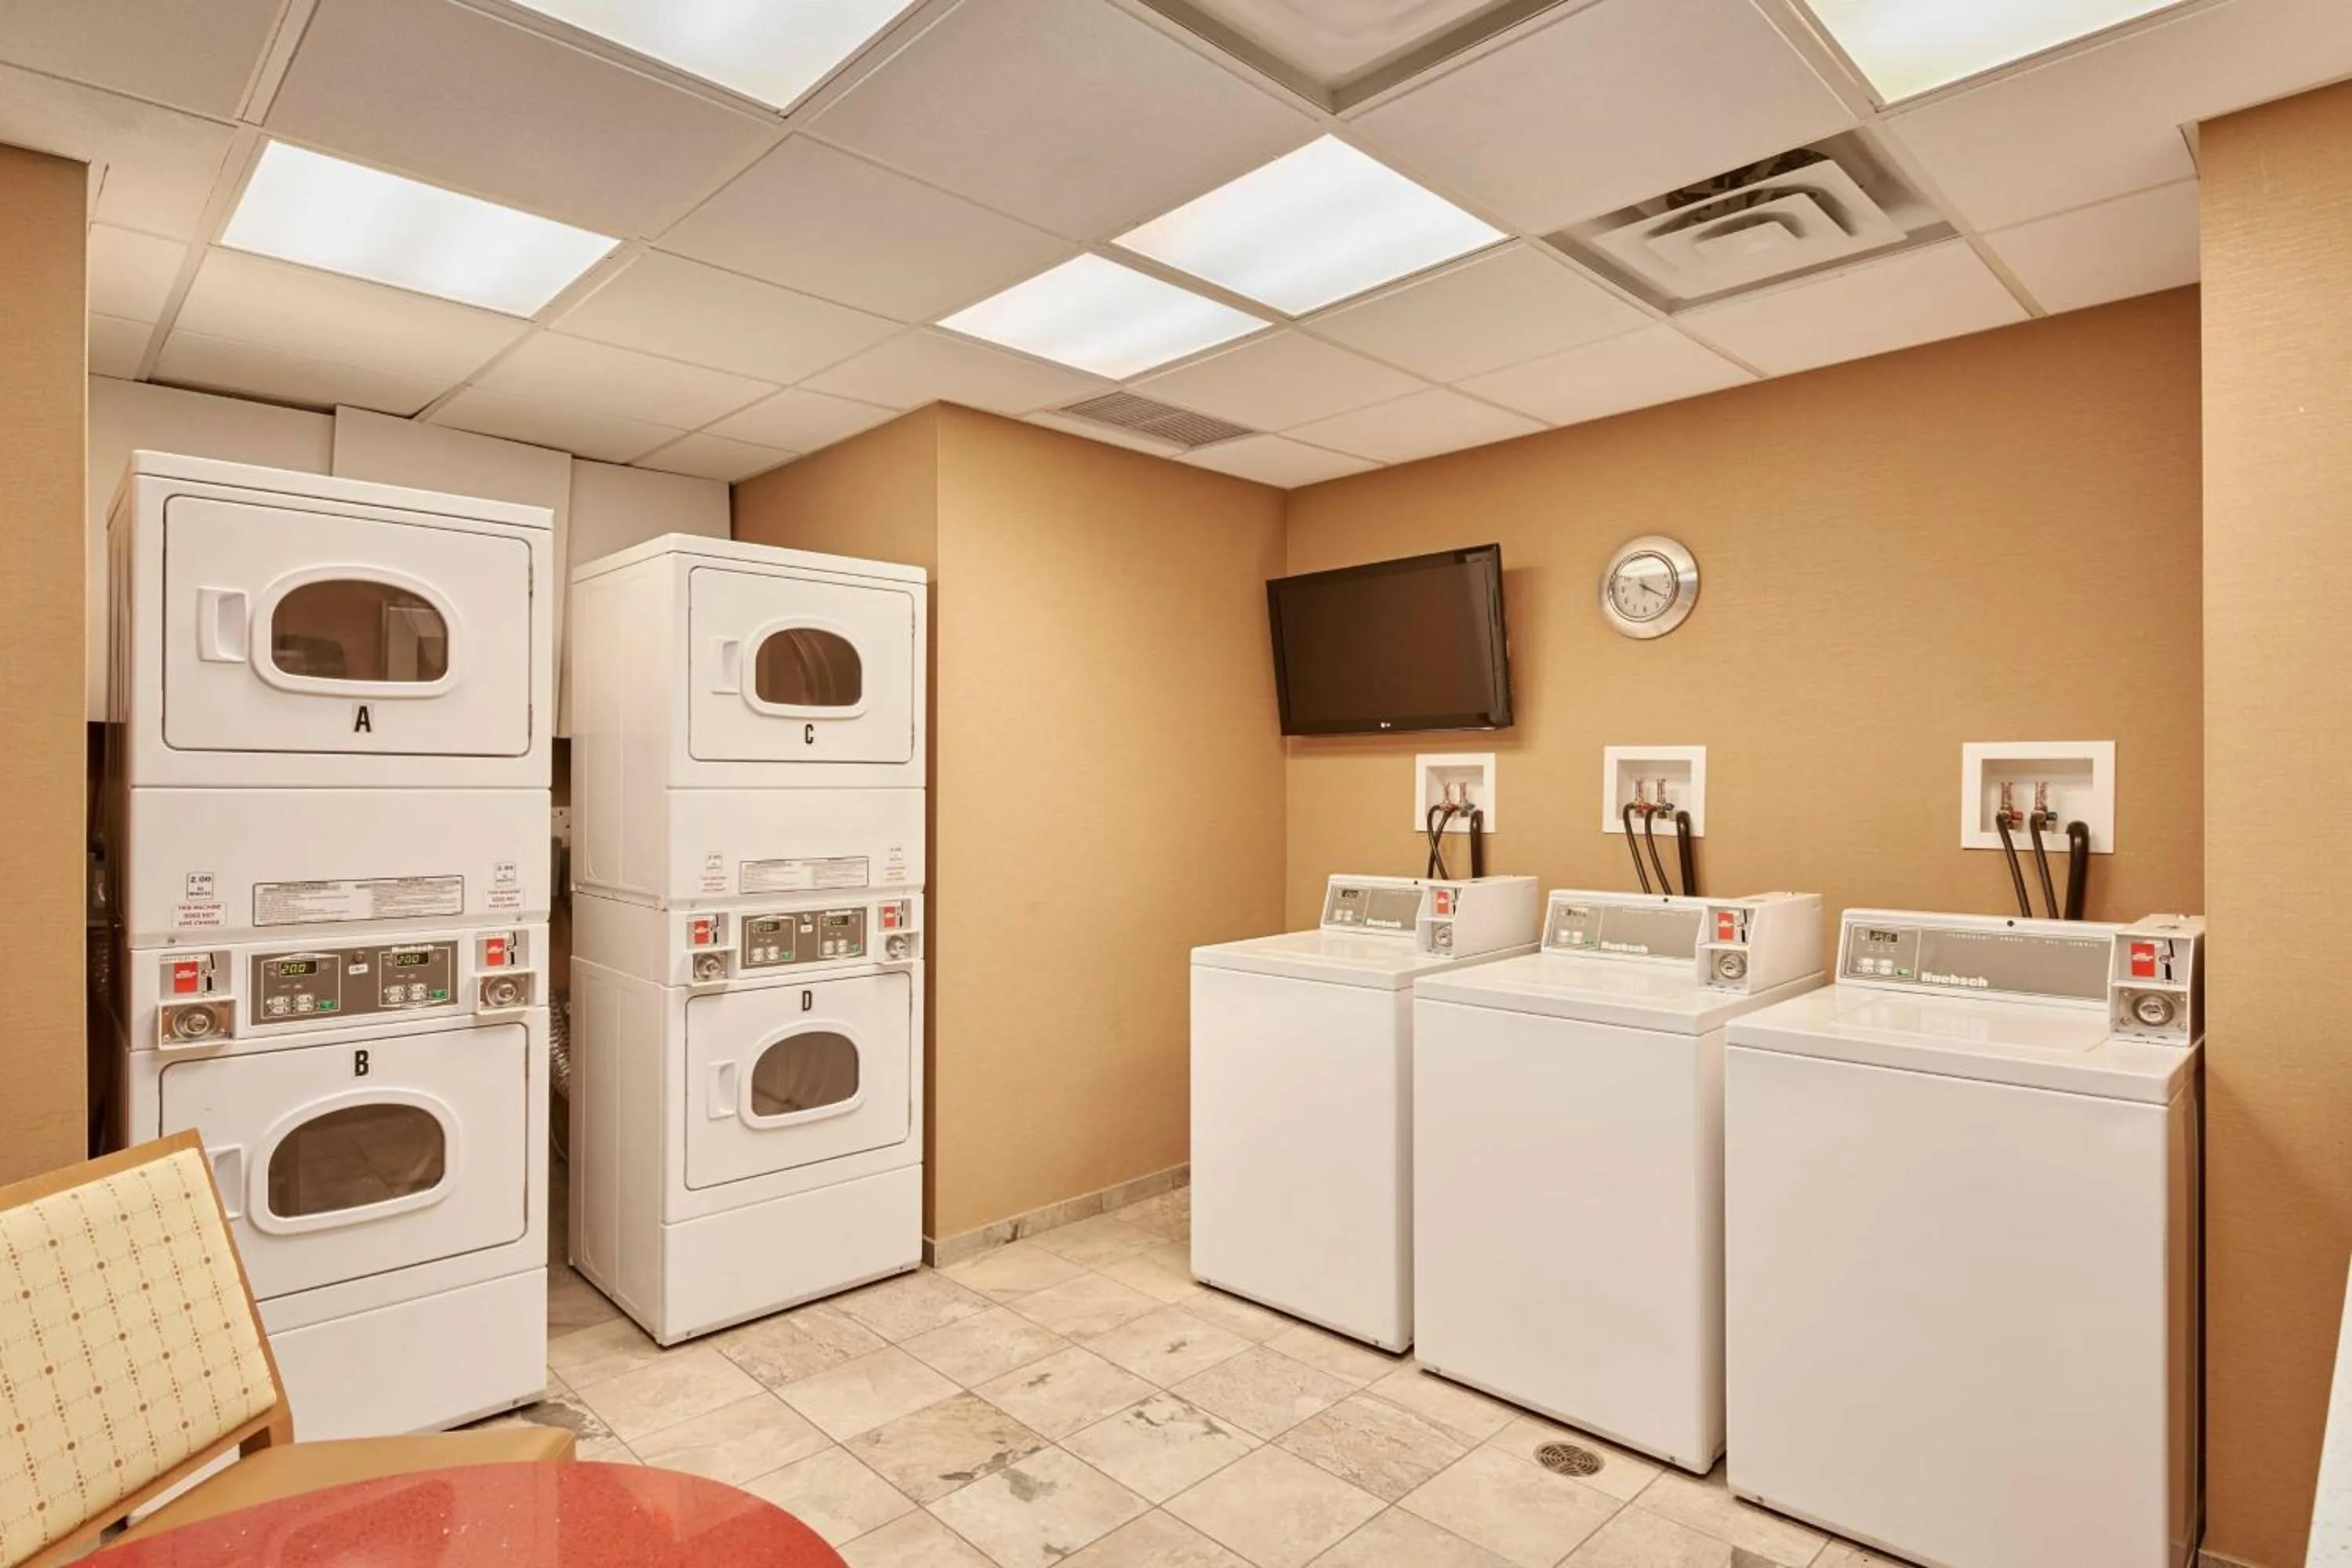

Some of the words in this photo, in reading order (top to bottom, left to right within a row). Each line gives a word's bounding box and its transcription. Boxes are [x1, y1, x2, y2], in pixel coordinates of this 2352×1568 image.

[354, 705, 372, 732] A
[805, 724, 814, 744] C
[1921, 971, 1989, 988] Huebsch
[802, 990, 812, 1011] D
[354, 1050, 369, 1076] B
